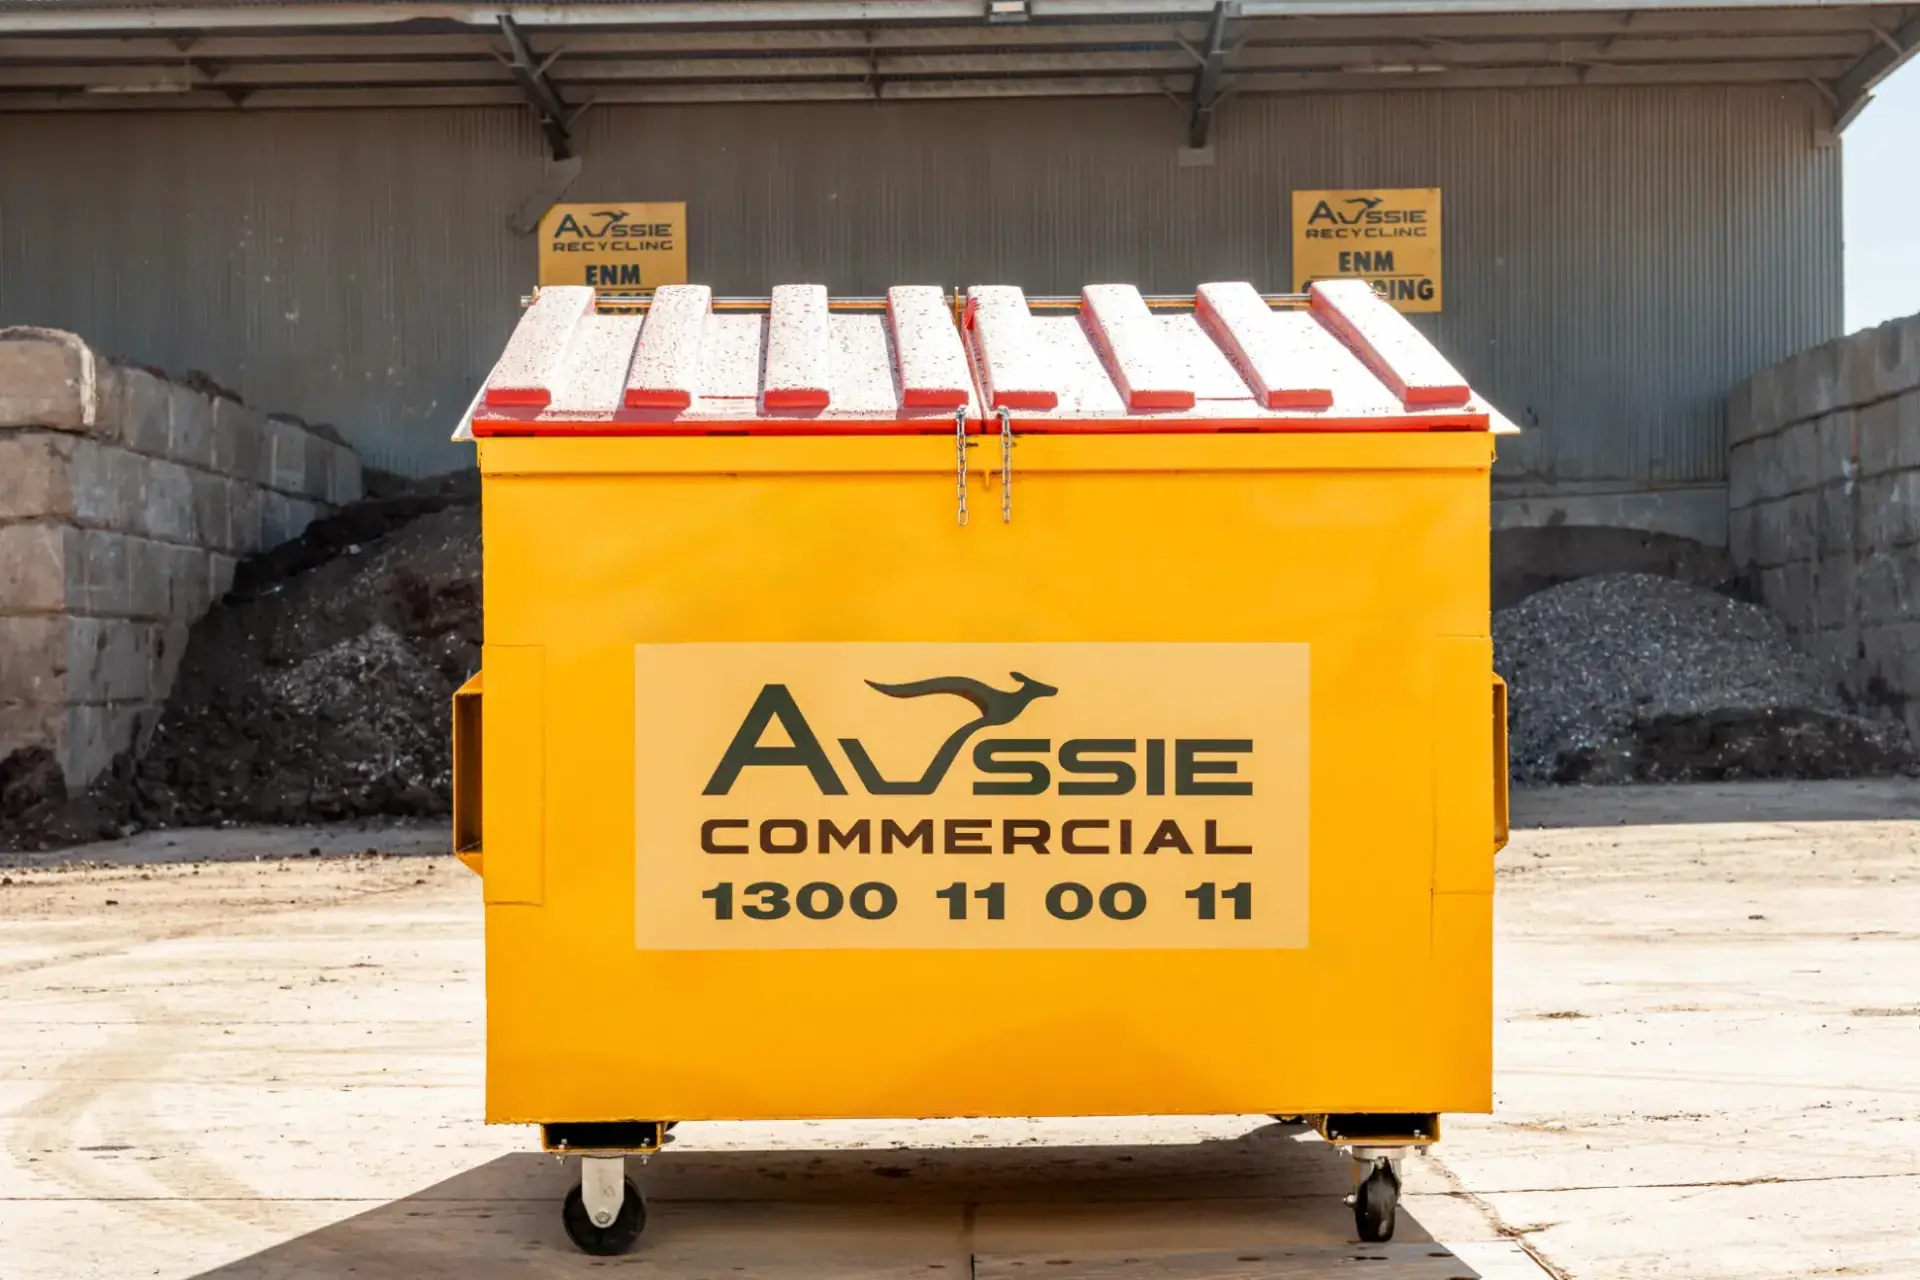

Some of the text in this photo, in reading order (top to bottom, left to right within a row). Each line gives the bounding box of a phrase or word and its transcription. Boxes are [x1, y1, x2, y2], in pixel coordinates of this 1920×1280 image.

[554, 210, 673, 238] AUSSIE
[1308, 197, 1427, 225] AUSSIE
[552, 240, 673, 252] RECYCLING
[1306, 227, 1427, 239] RECYCLING
[585, 264, 641, 285] ENM
[1339, 251, 1394, 272] ENM
[702, 672, 1253, 795] AUSSIE
[701, 819, 1252, 854] COMMERCIAL
[702, 882, 1252, 920] 1300 11 00 11
